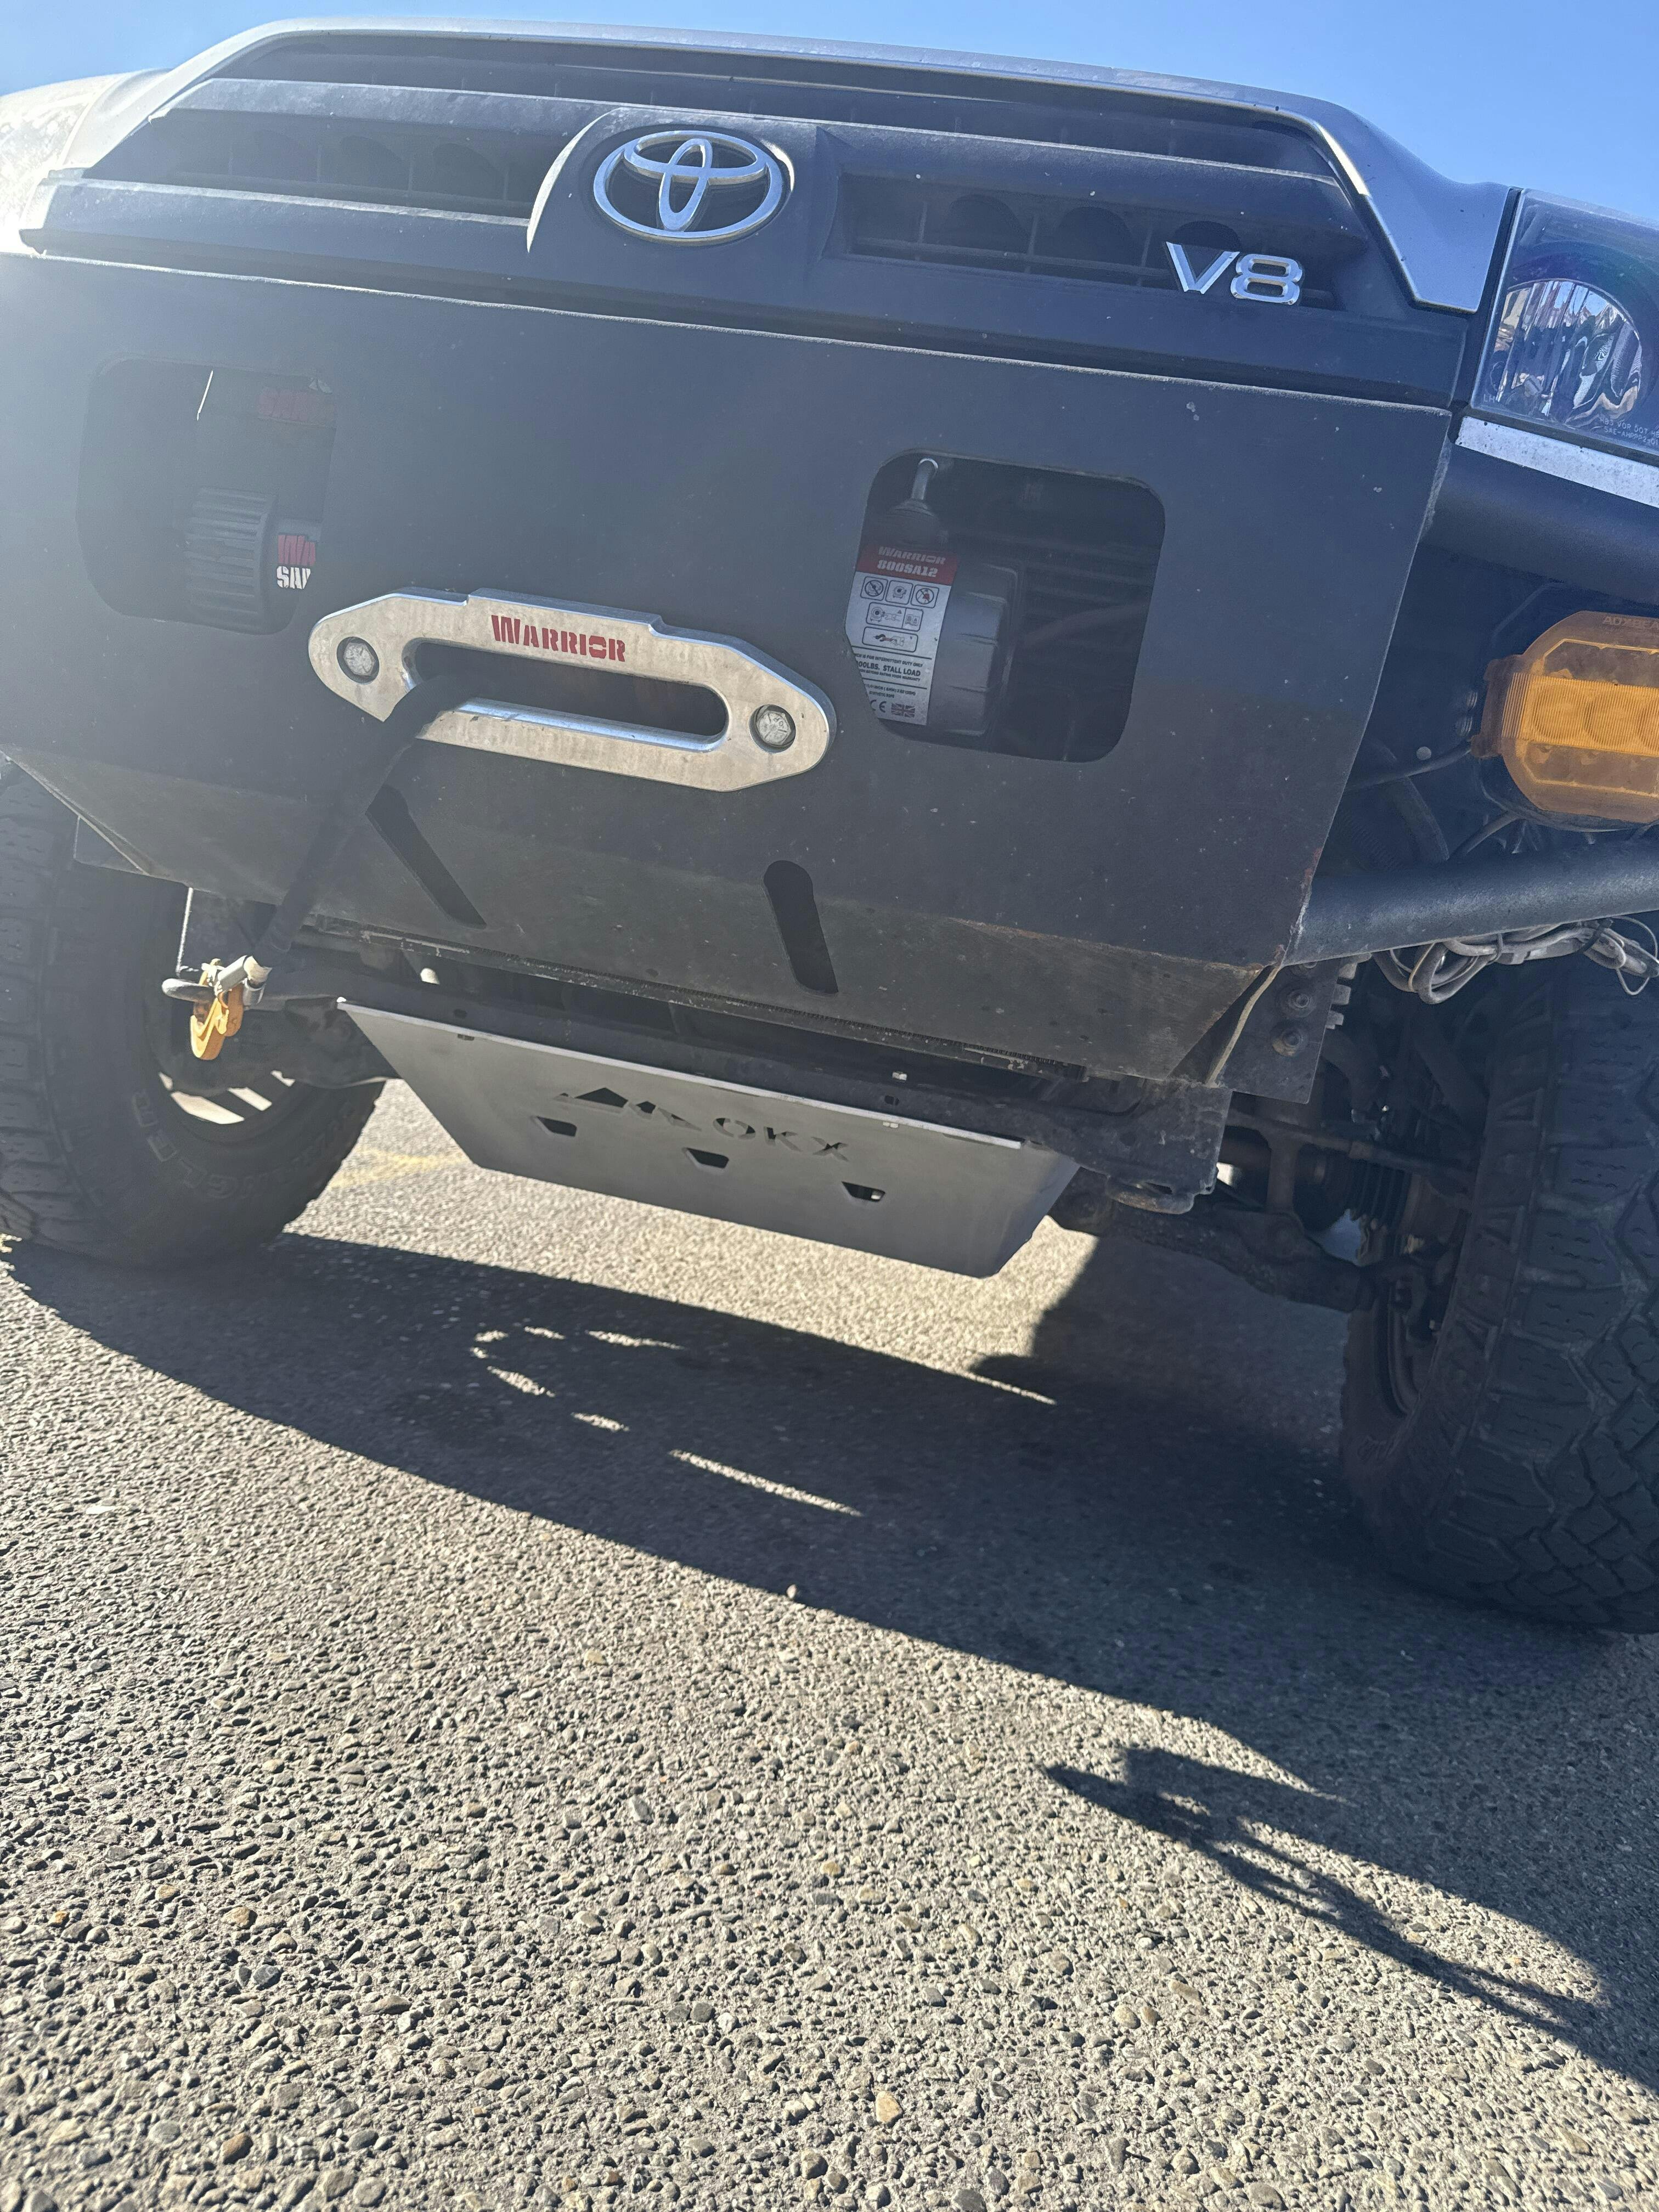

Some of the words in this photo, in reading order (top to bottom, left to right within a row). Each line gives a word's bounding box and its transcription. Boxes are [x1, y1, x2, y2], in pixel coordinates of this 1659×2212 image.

[1165, 241, 1303, 306] V8
[1634, 425, 1648, 434] DOT
[878, 546, 946, 565] WARRIOR
[492, 614, 625, 662] WARRIOR
[857, 661, 880, 670] 00LBS.
[883, 665, 901, 674] STALL
[903, 668, 921, 676] LOAD
